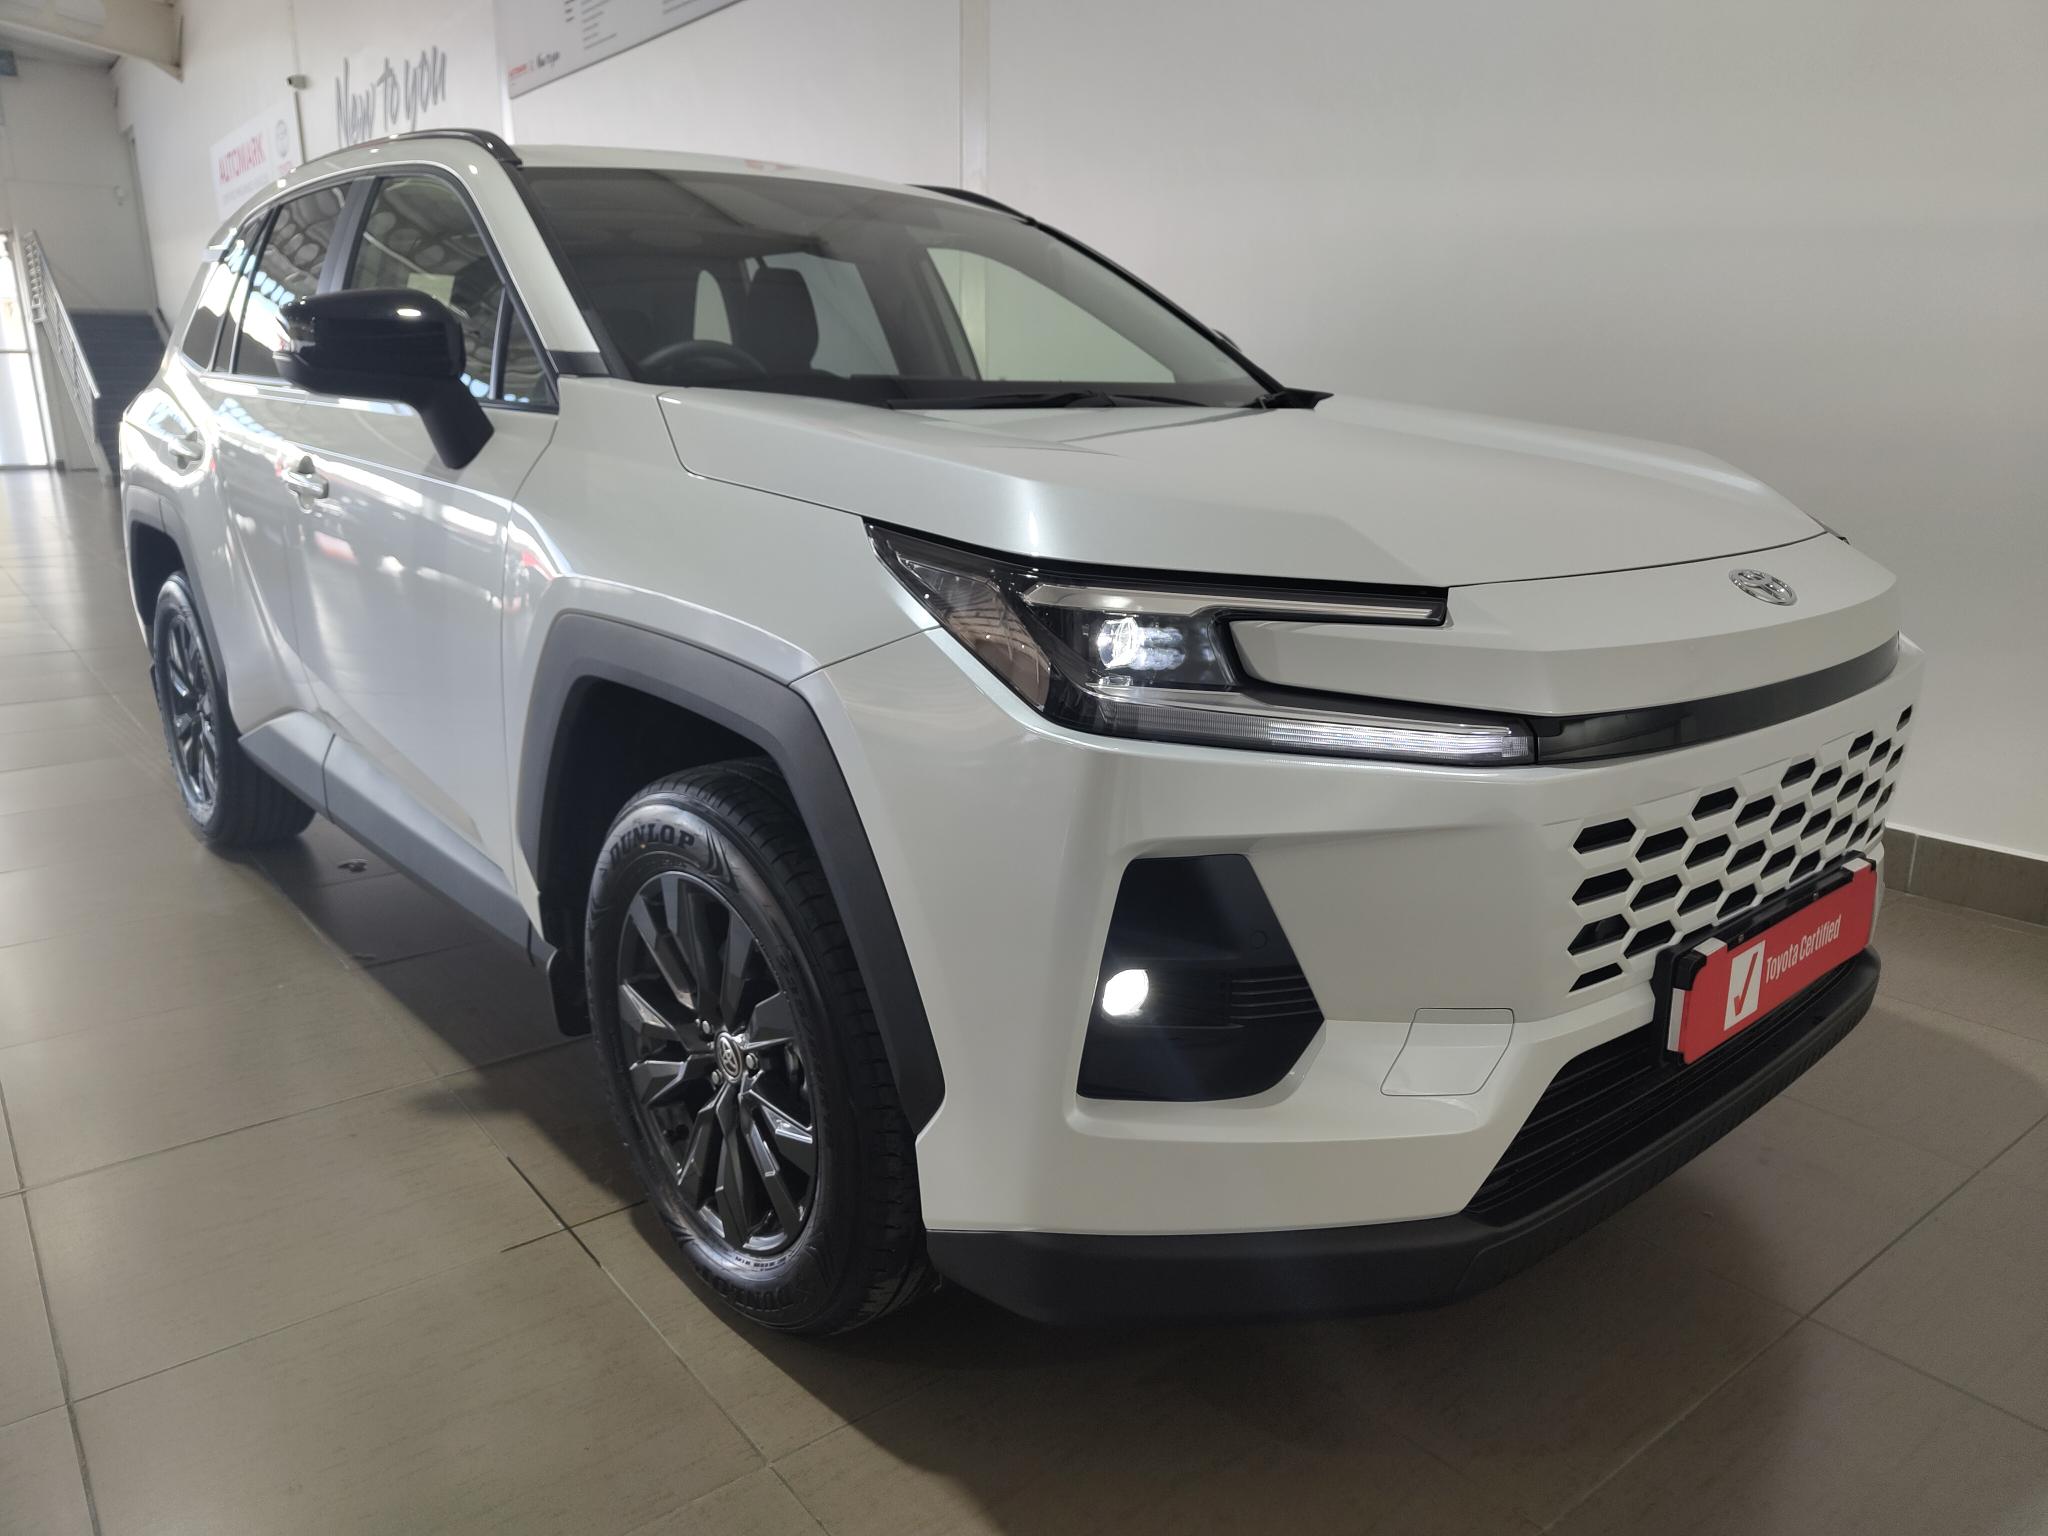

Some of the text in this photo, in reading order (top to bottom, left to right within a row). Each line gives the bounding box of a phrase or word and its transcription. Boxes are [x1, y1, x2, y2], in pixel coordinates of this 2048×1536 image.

[335, 45, 446, 147] New to you
[219, 134, 265, 184] AUTOMARK
[610, 823, 695, 863] DUNLOP
[1766, 914, 1841, 984] Toyota Certified
